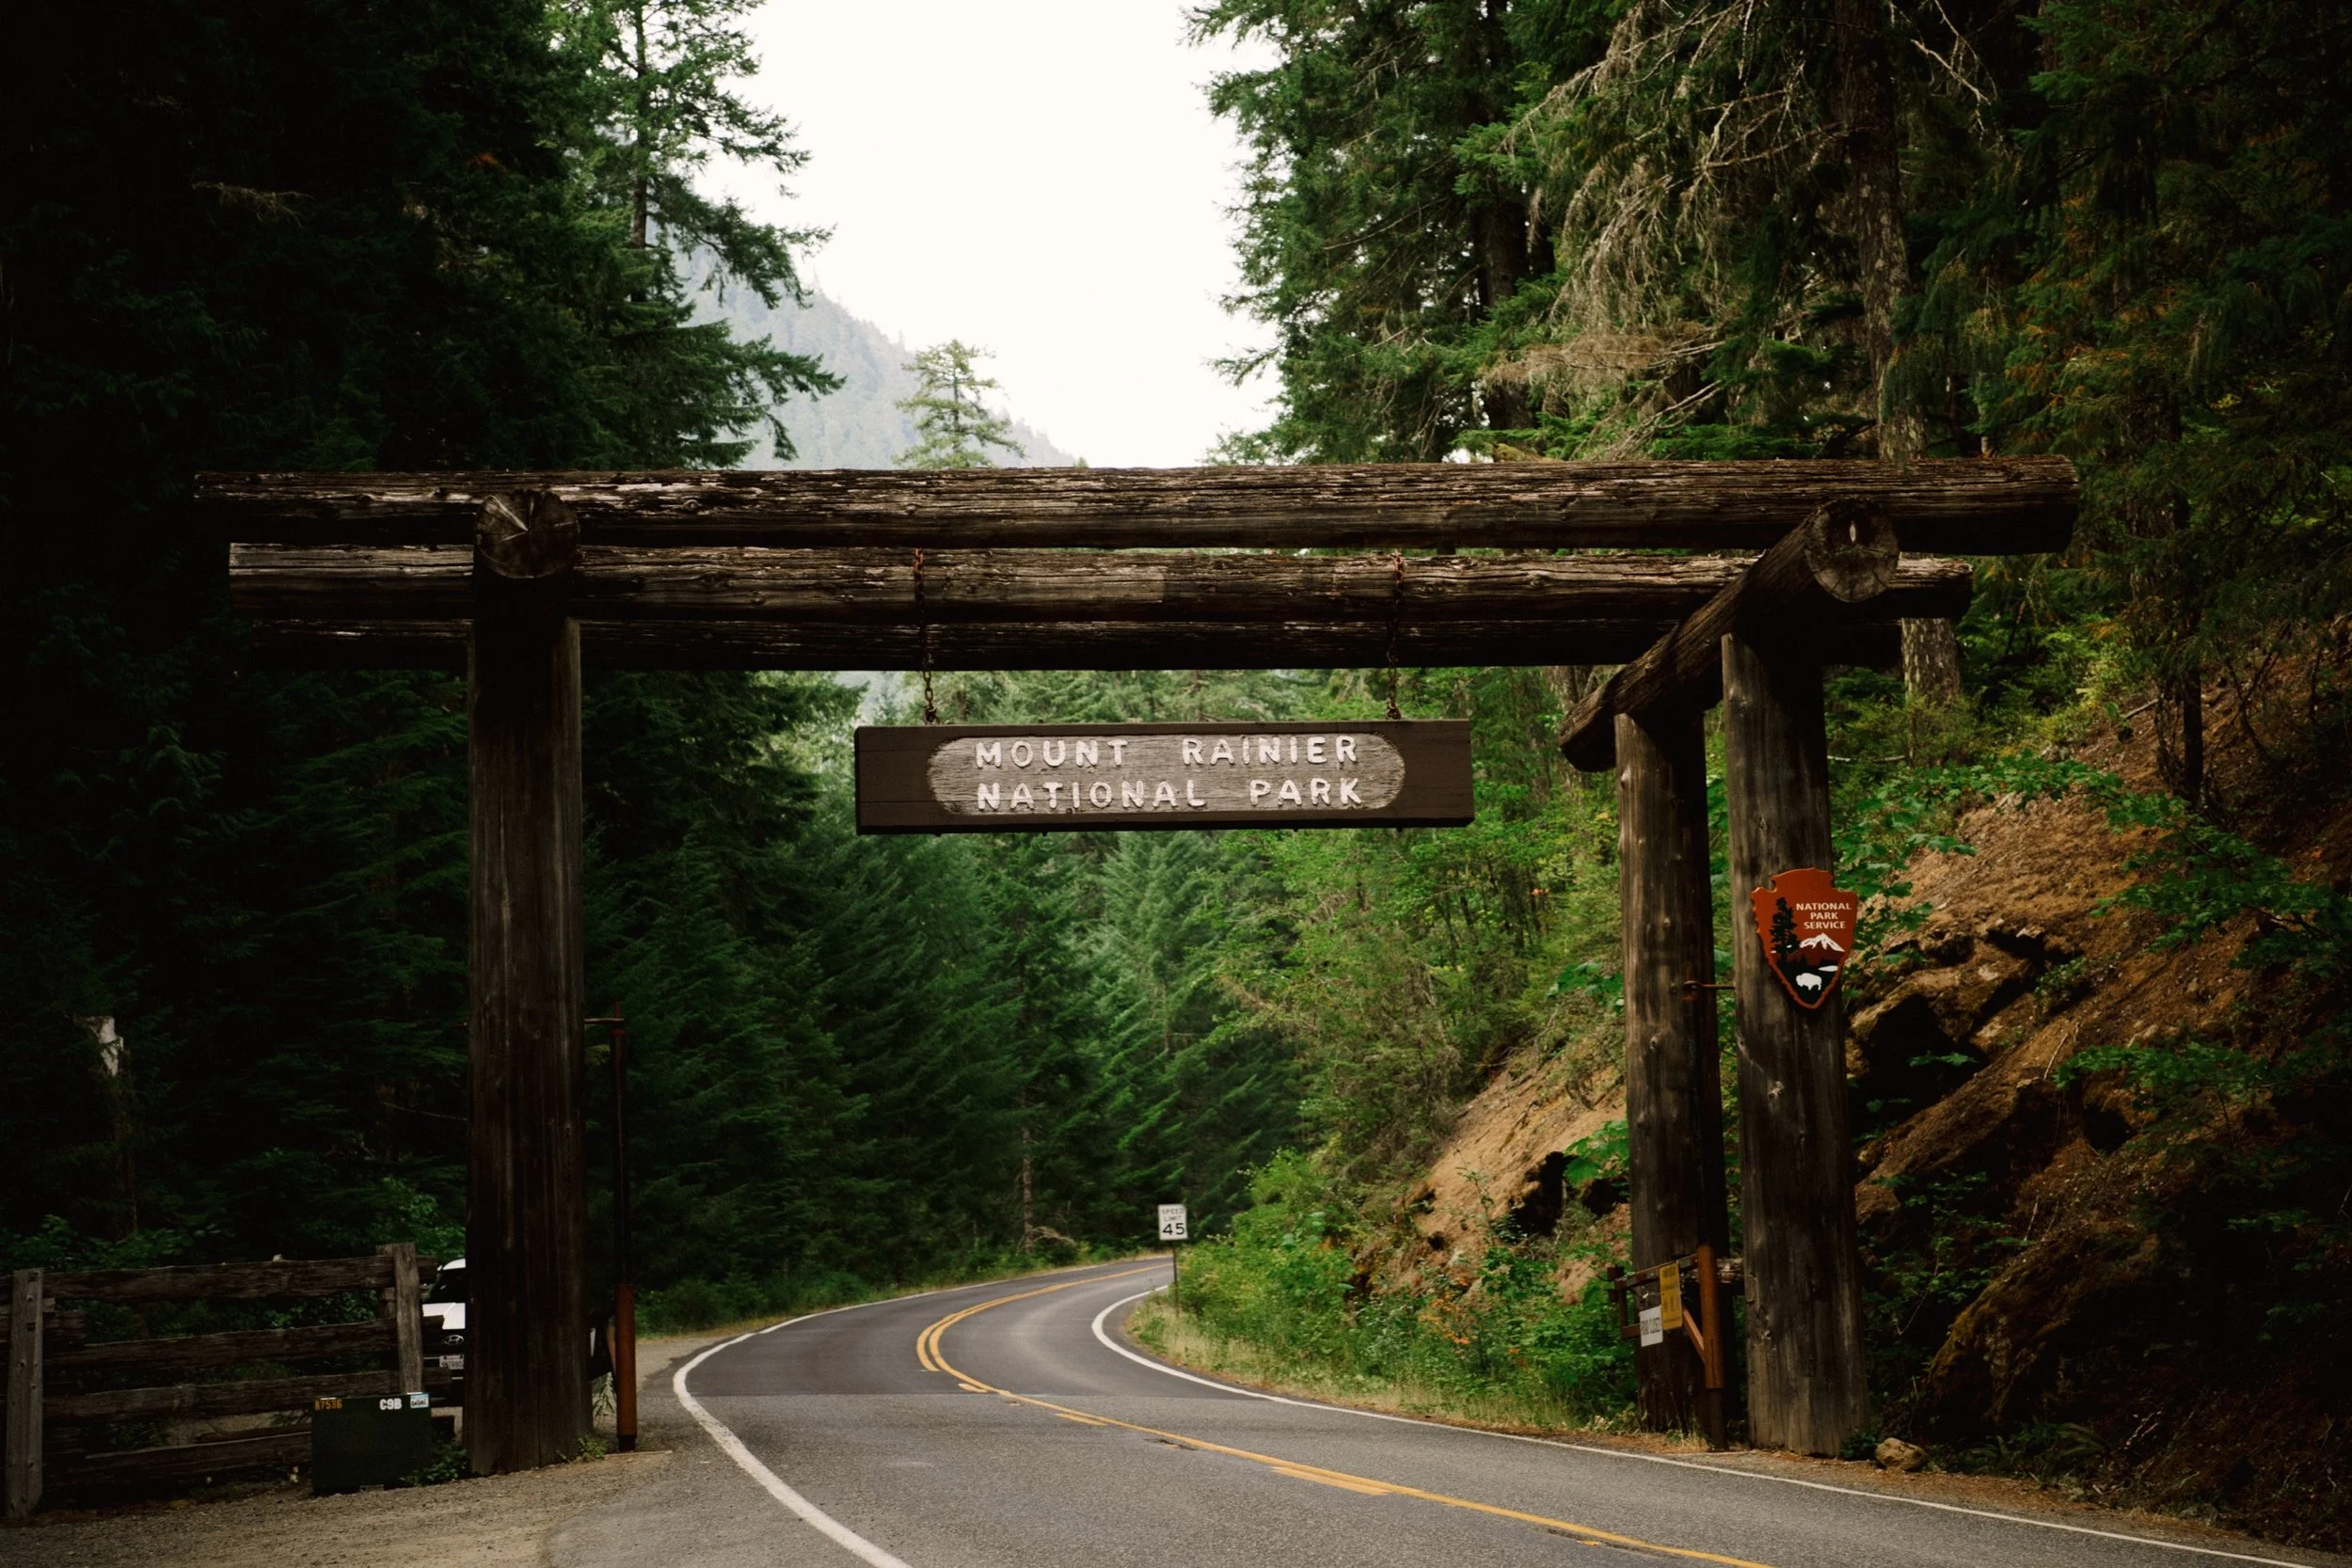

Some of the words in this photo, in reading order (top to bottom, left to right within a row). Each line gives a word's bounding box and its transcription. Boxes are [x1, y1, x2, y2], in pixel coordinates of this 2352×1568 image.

[976, 739, 1129, 768] MOUNT
[1182, 736, 1358, 765] RAINIER
[977, 780, 1207, 810] NATIONAL
[1249, 778, 1362, 806] PARK
[1795, 902, 1851, 911] NATIONAL
[1810, 911, 1838, 920] PARK
[1804, 921, 1846, 929] SERVICE
[1162, 1223, 1184, 1235] 45
[379, 1398, 402, 1410] C9B
